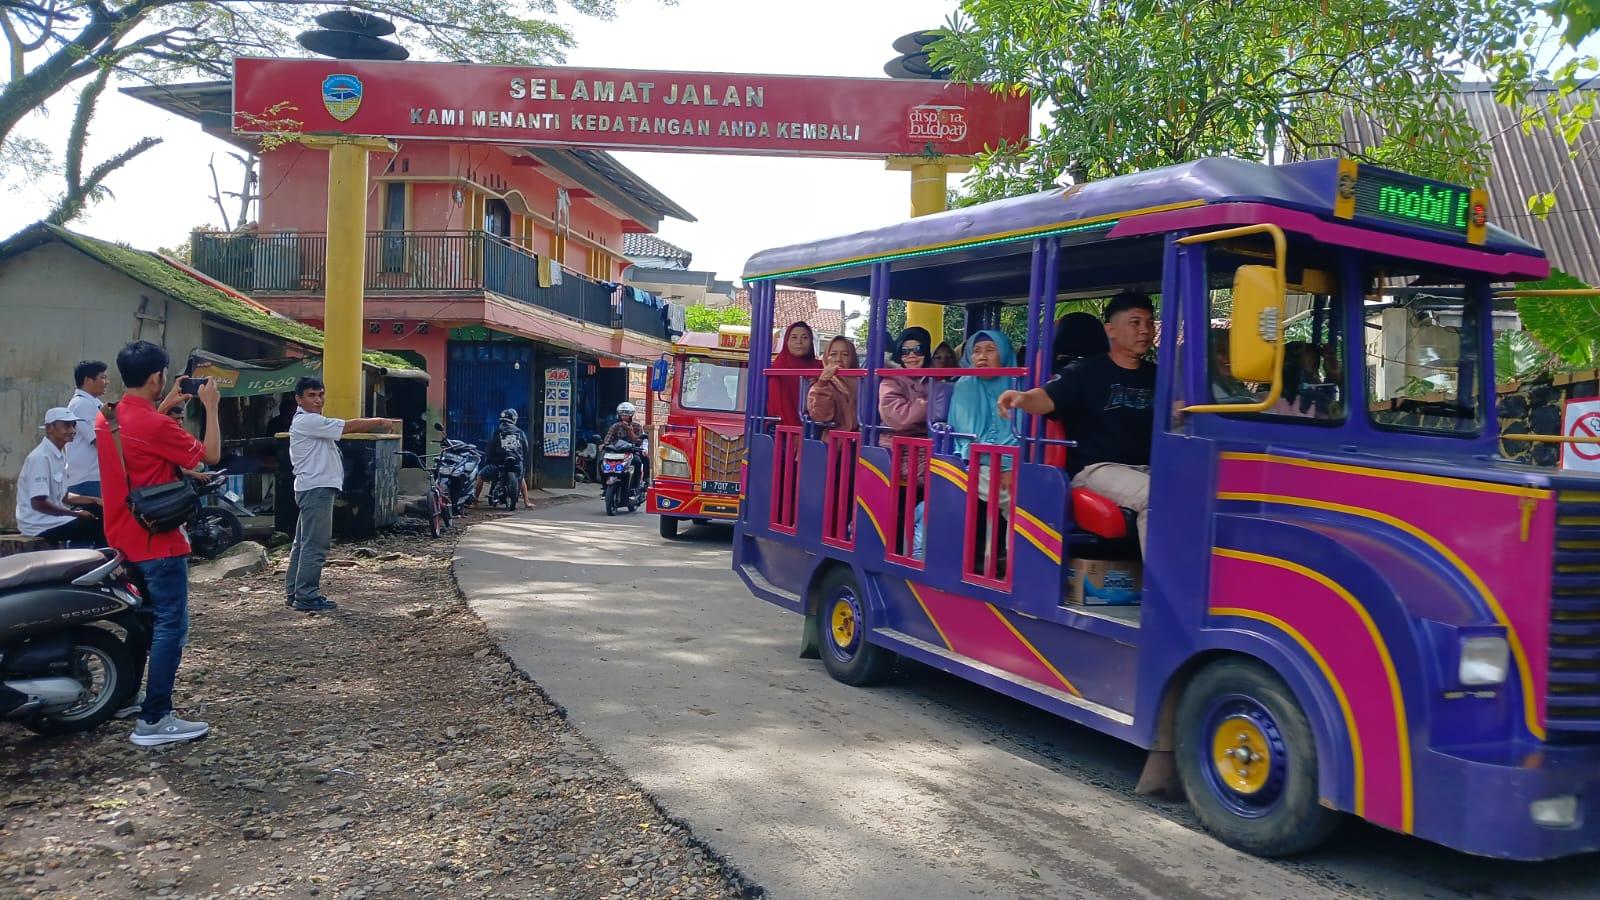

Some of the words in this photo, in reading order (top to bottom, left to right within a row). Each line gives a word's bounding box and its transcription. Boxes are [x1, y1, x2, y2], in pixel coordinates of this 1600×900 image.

[509, 77, 655, 104] SELAMAT
[662, 83, 764, 108] JALAN
[410, 107, 465, 126] KAMI
[471, 110, 561, 130] MENANTI
[571, 114, 710, 136] KEDATANGAN
[718, 120, 771, 138] ANDA
[776, 121, 861, 141] KEMBALI
[1379, 185, 1452, 223] mobil
[247, 376, 296, 389] 11.000
